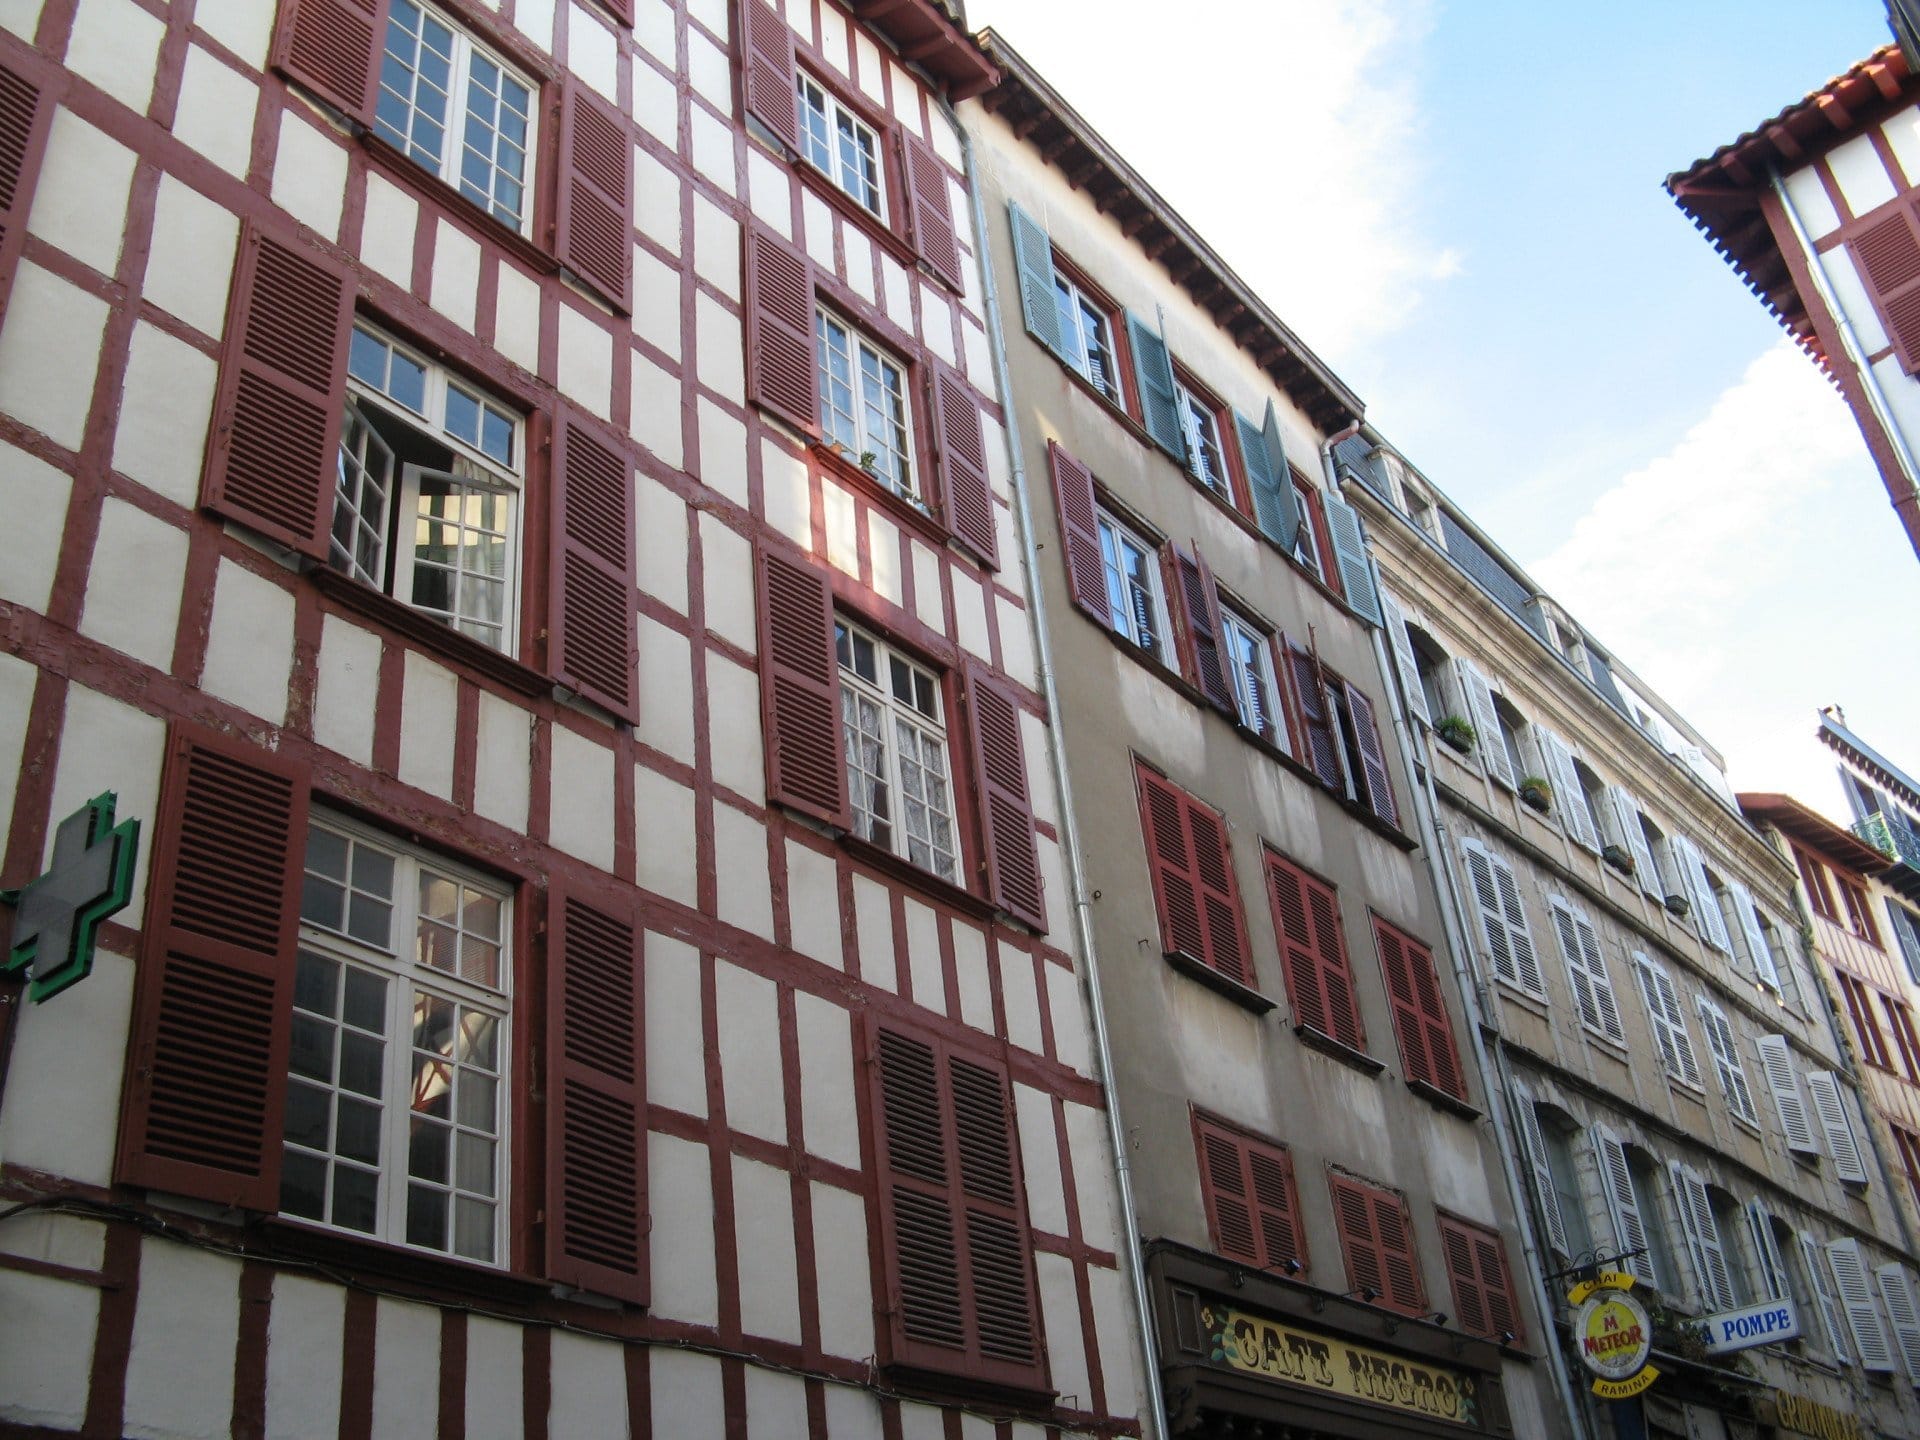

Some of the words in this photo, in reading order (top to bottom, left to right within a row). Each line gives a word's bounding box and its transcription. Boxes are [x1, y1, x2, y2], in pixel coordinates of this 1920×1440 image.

[1583, 1325, 1647, 1357] METEOR
[1722, 1308, 1791, 1342] POMPE
[1345, 1349, 1458, 1417] NEGRO
[1601, 1375, 1648, 1395] RAMINA
